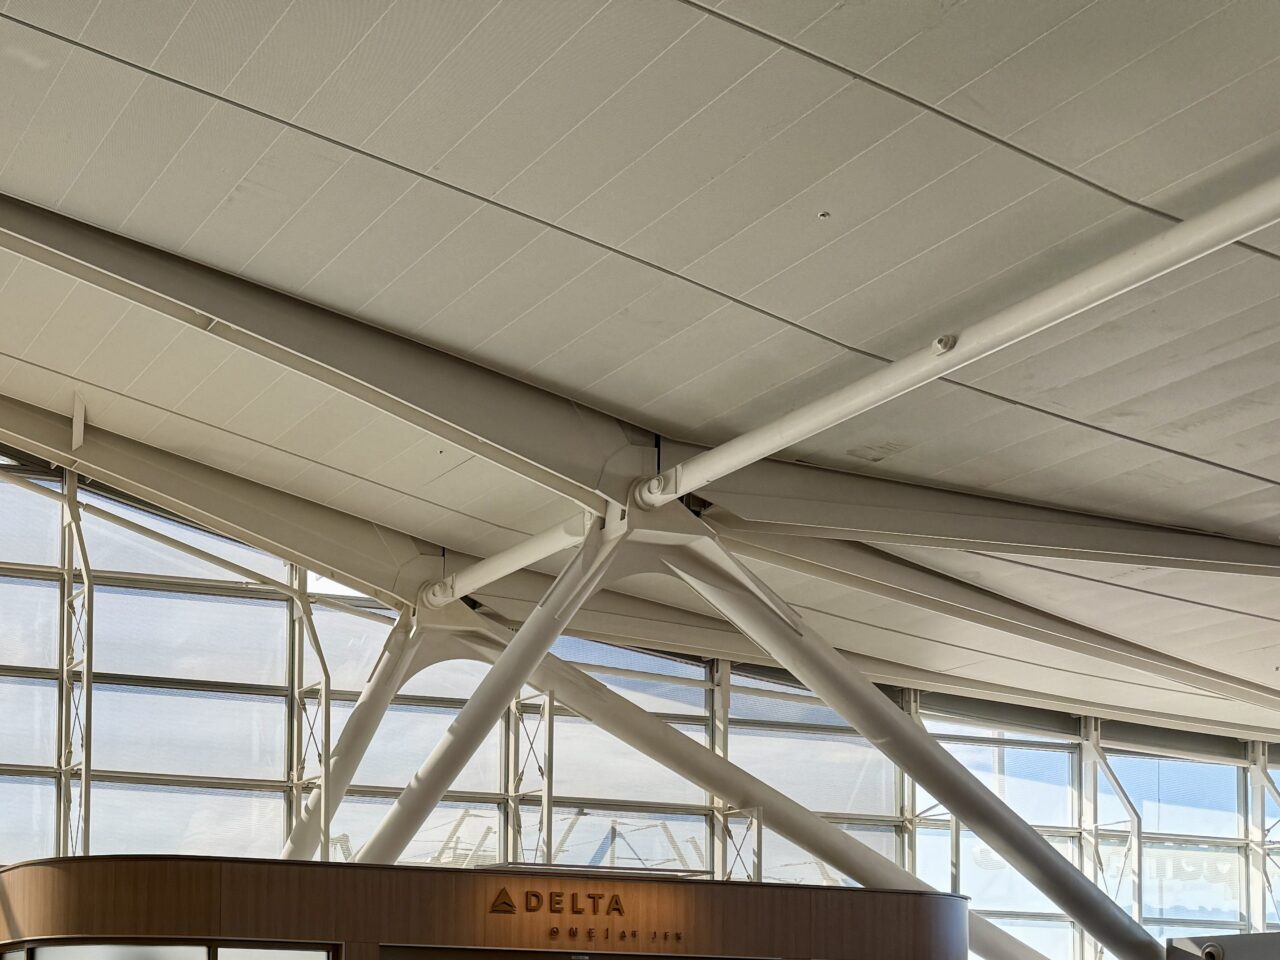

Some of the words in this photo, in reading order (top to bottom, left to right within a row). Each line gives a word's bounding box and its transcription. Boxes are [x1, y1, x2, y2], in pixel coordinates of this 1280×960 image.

[525, 890, 625, 916] DELTA
[550, 926, 595, 941] ONE
[651, 930, 683, 942] JFK
